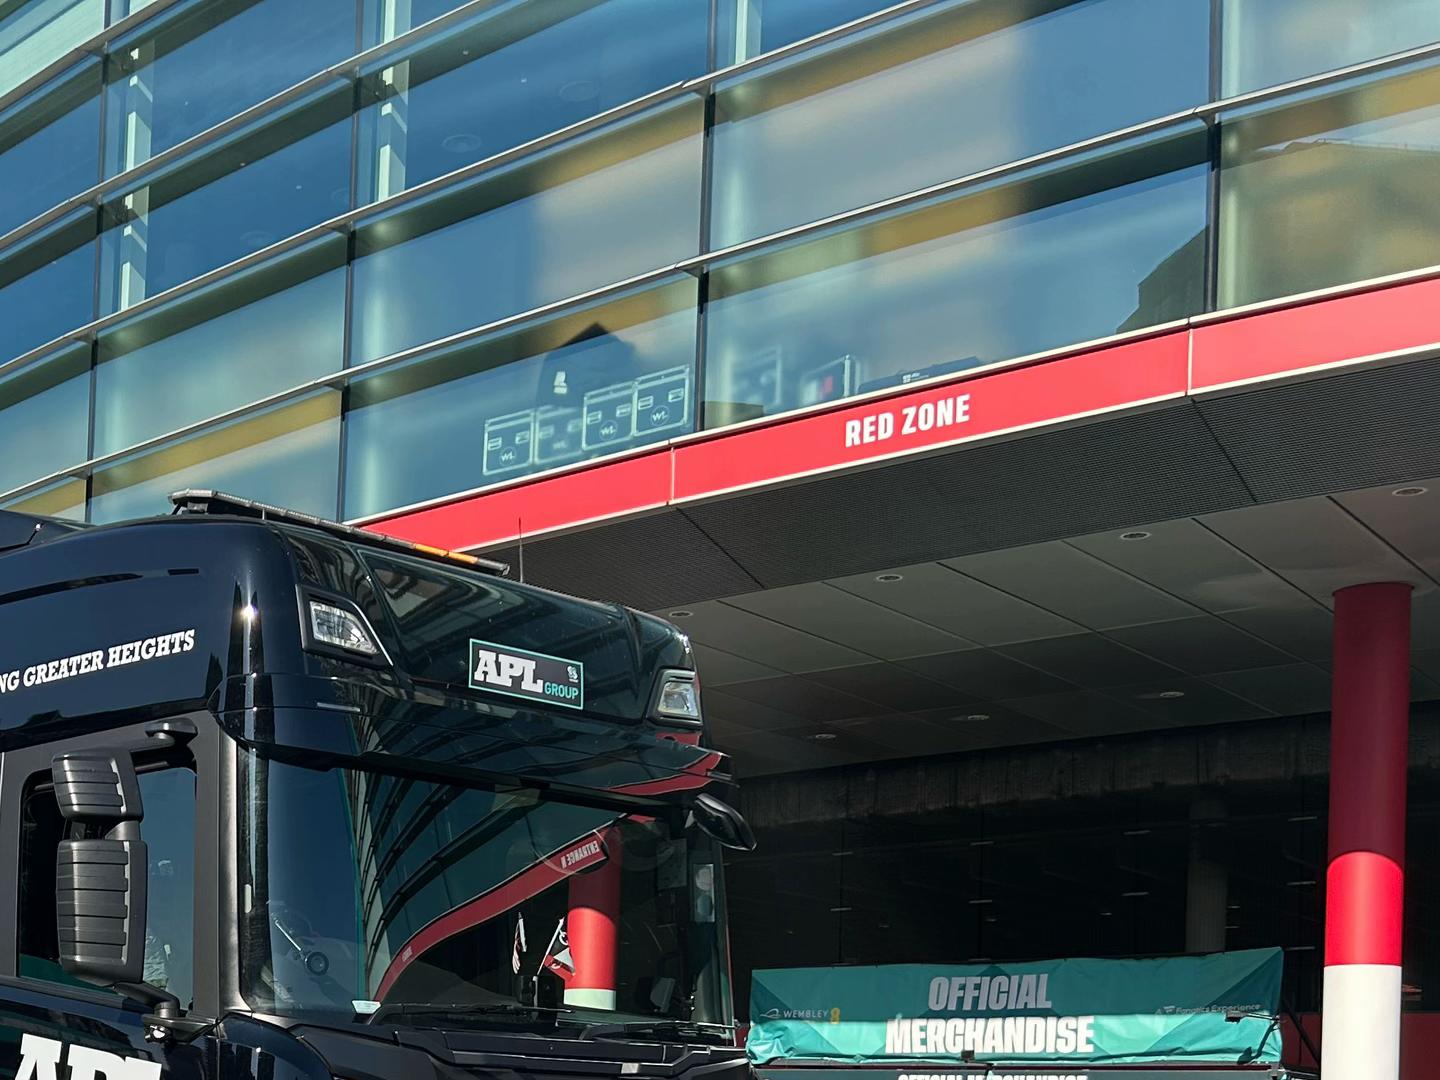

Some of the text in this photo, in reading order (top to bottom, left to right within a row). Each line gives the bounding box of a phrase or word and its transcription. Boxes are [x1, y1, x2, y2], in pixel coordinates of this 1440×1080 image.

[845, 394, 971, 448] RED ZONE
[23, 651, 103, 688] GREATER
[107, 629, 195, 668] HEIGHTS
[474, 650, 543, 692] APL
[544, 681, 579, 701] GROUP
[928, 973, 1052, 1011] OFFICIAL
[783, 1009, 829, 1018] WEMBLEY
[885, 1015, 1095, 1054] MERCHANDISE
